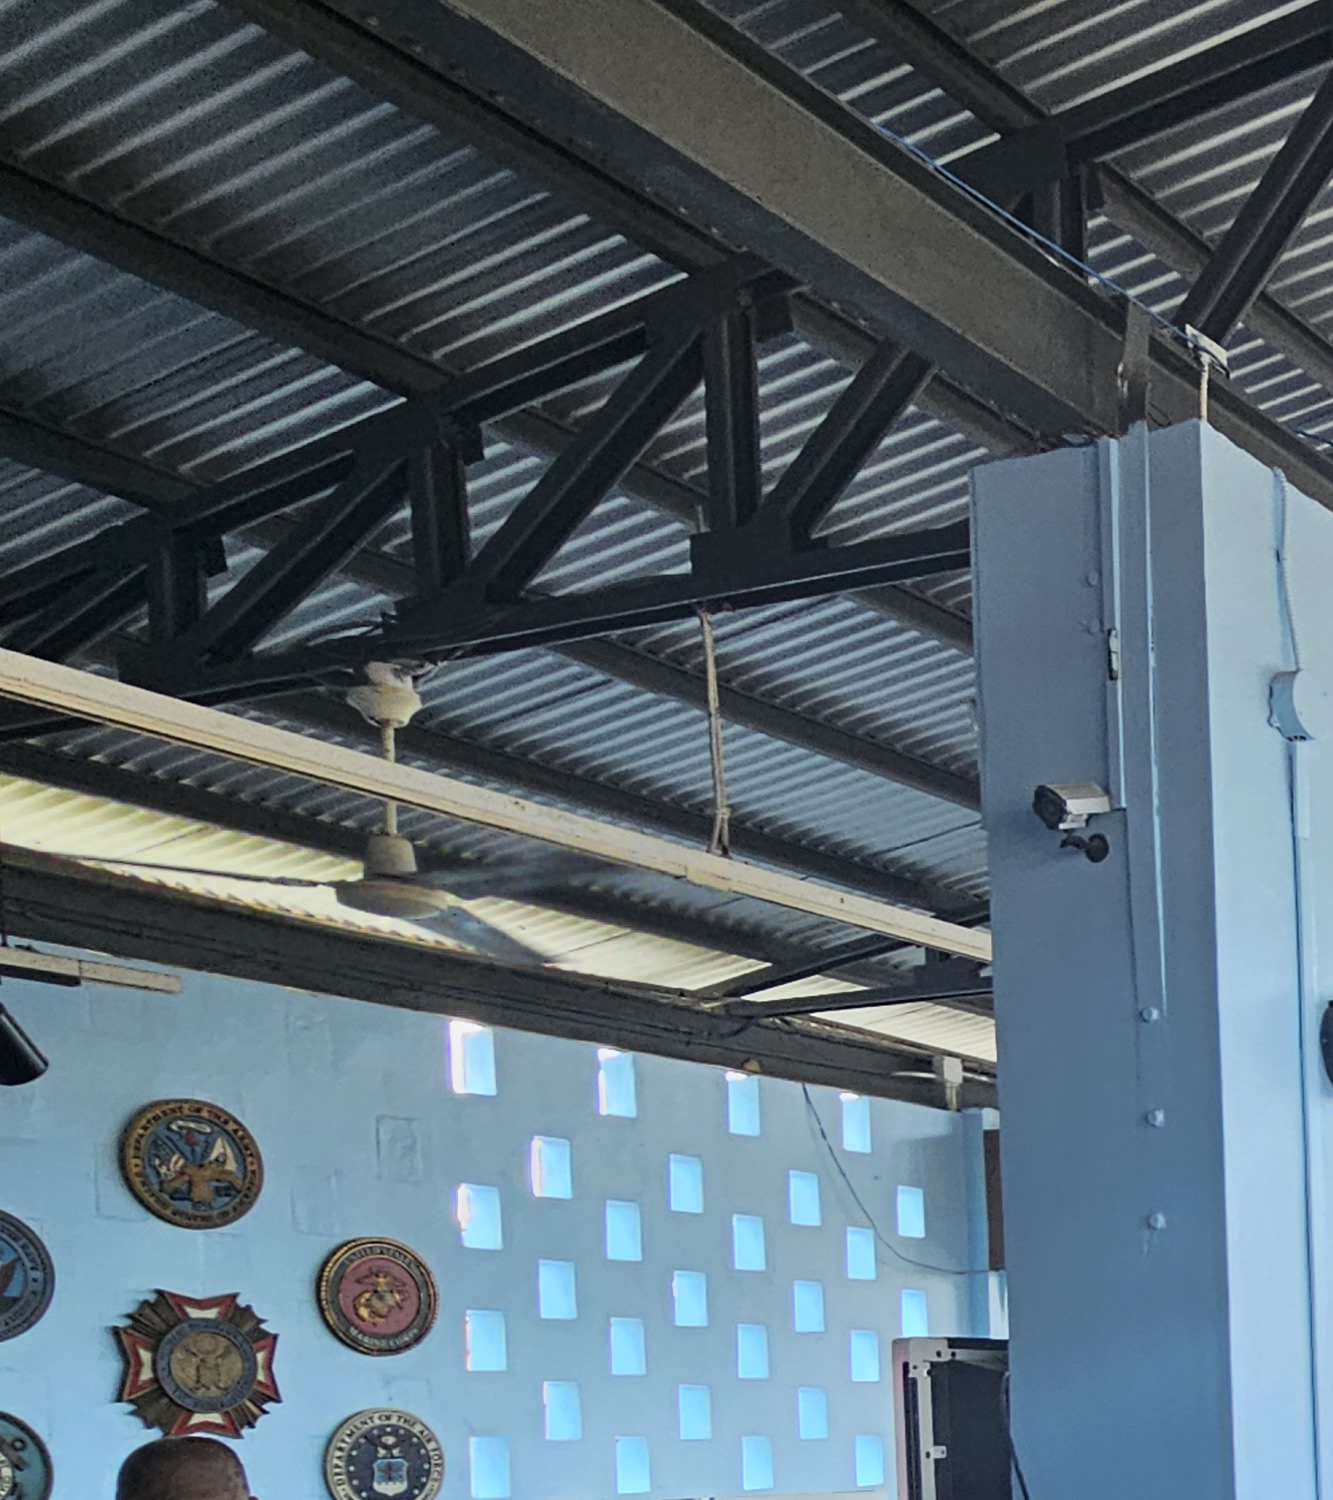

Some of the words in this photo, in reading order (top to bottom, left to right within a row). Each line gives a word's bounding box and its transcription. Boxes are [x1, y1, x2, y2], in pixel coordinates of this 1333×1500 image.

[132, 1105, 184, 1161] DEPARTMENT
[349, 1327, 388, 1347] MARINE
[333, 1416, 375, 1487] DEPARTMENT
[396, 1415, 417, 1428] THE
[419, 1429, 434, 1443] AIR
